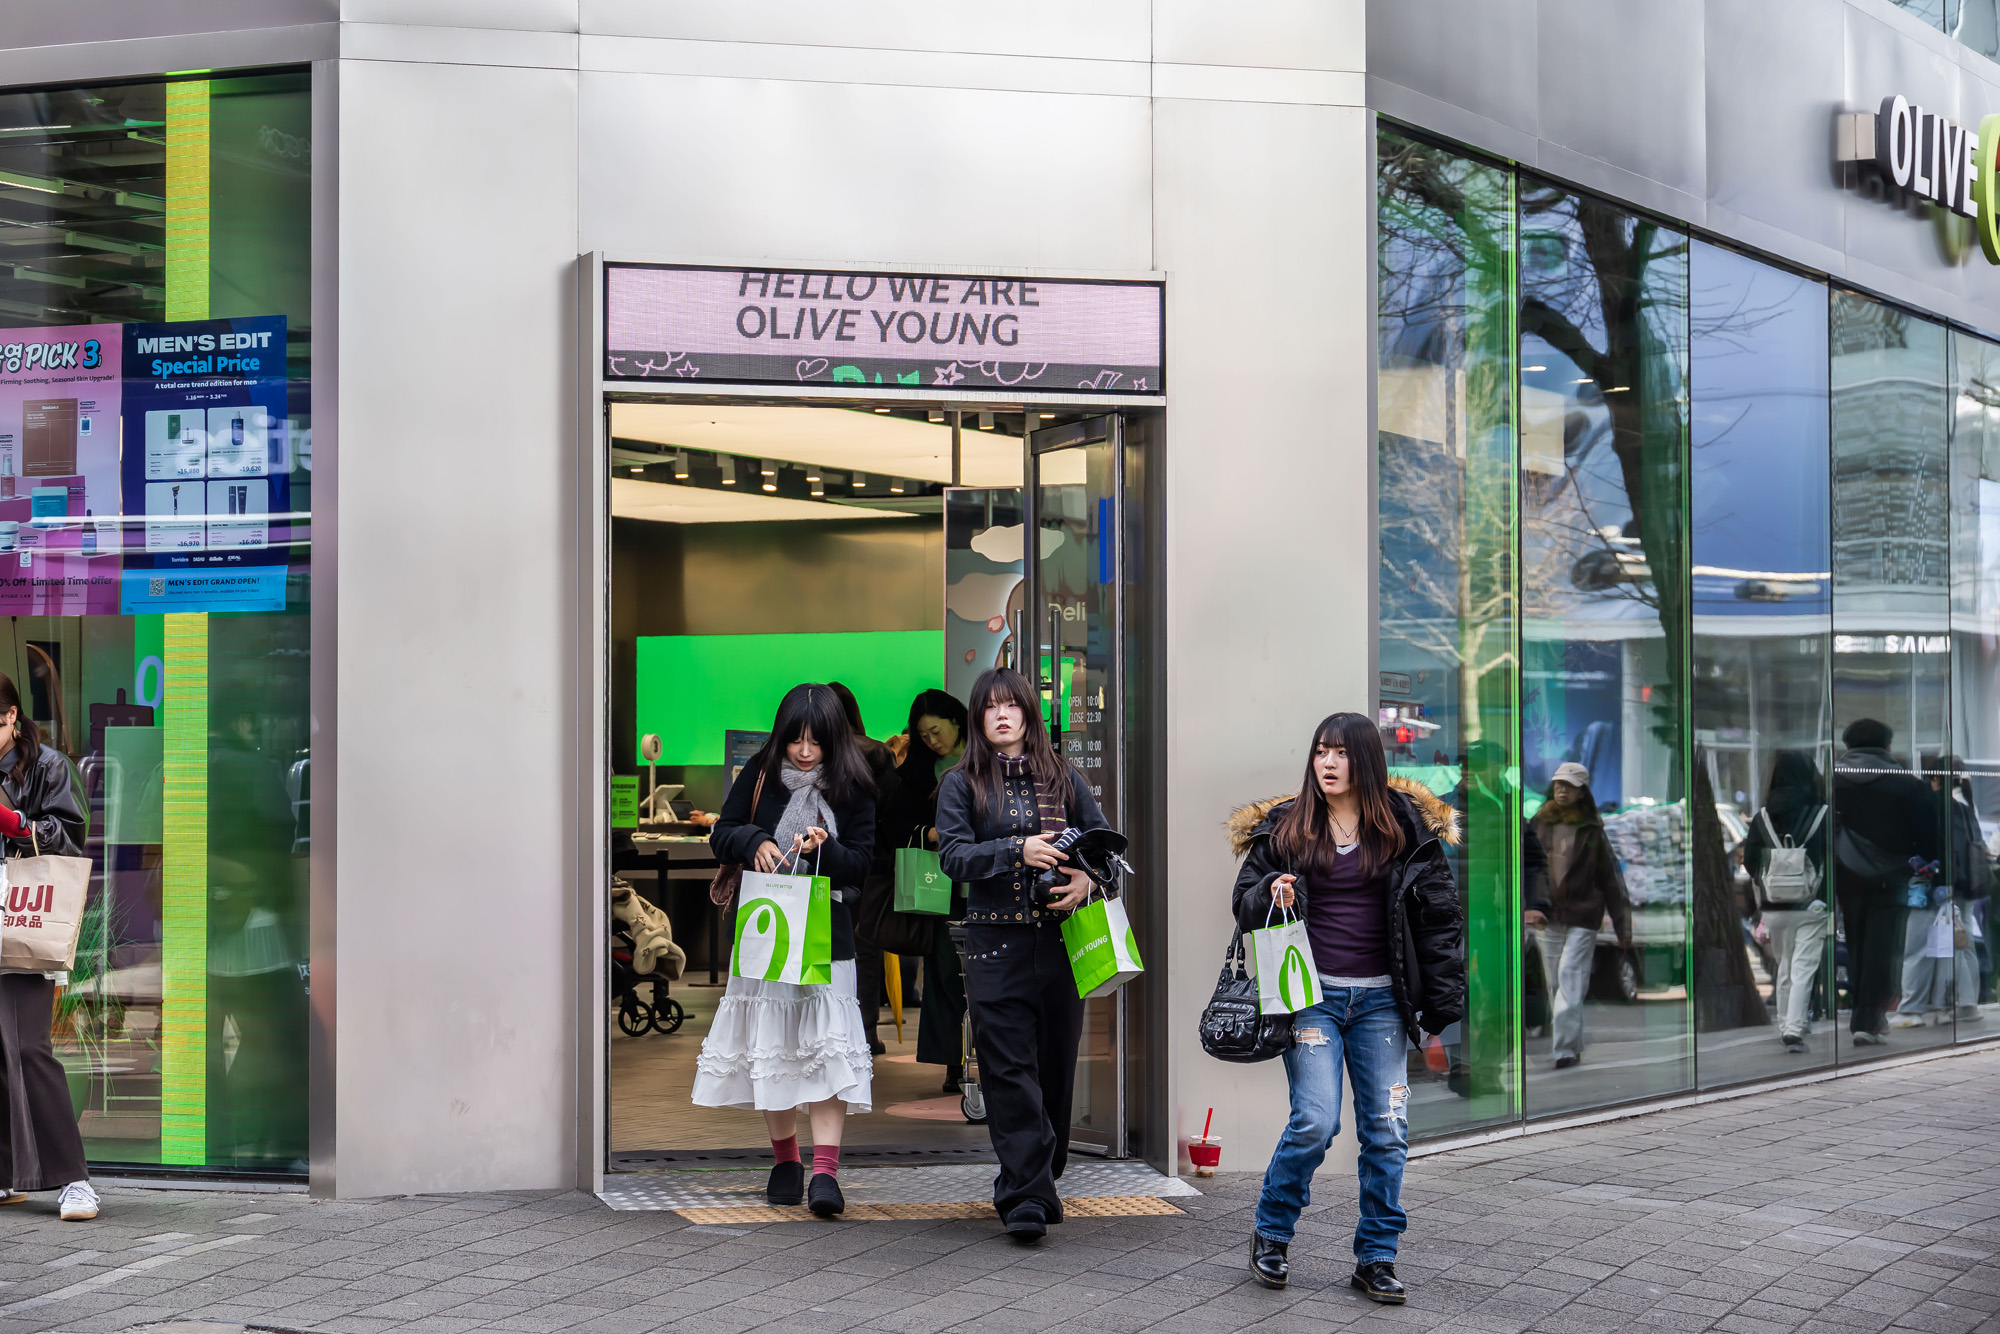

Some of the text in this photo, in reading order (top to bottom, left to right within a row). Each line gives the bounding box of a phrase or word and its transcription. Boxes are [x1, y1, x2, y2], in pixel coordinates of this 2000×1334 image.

[1889, 94, 1980, 218] OLIVE
[738, 273, 1040, 307] HELLO WE ARE
[736, 305, 1020, 346] OLIVE YOUNG
[137, 332, 272, 354] MEN'S EDIT
[24, 339, 101, 371] PICK 3
[151, 353, 260, 380] Special Price
[51, 375, 76, 383] Seasonal
[76, 374, 89, 382] Skin
[89, 374, 115, 382] Upgrade!
[12, 578, 27, 587] Off
[32, 577, 65, 586] Limited
[67, 576, 89, 586] Time
[91, 575, 113, 585] Offer
[1068, 696, 1082, 707] OPEN
[1069, 712, 1101, 723] CLOSE 22:30
[1068, 740, 1101, 751] OPEN 10:00
[1087, 757, 1101, 768] 23:00
[1088, 785, 1102, 796] 0:00
[8, 884, 54, 913] UJI
[3, 914, 43, 928] 印良品
[1072, 935, 1108, 963] OLIVE YOUNG
